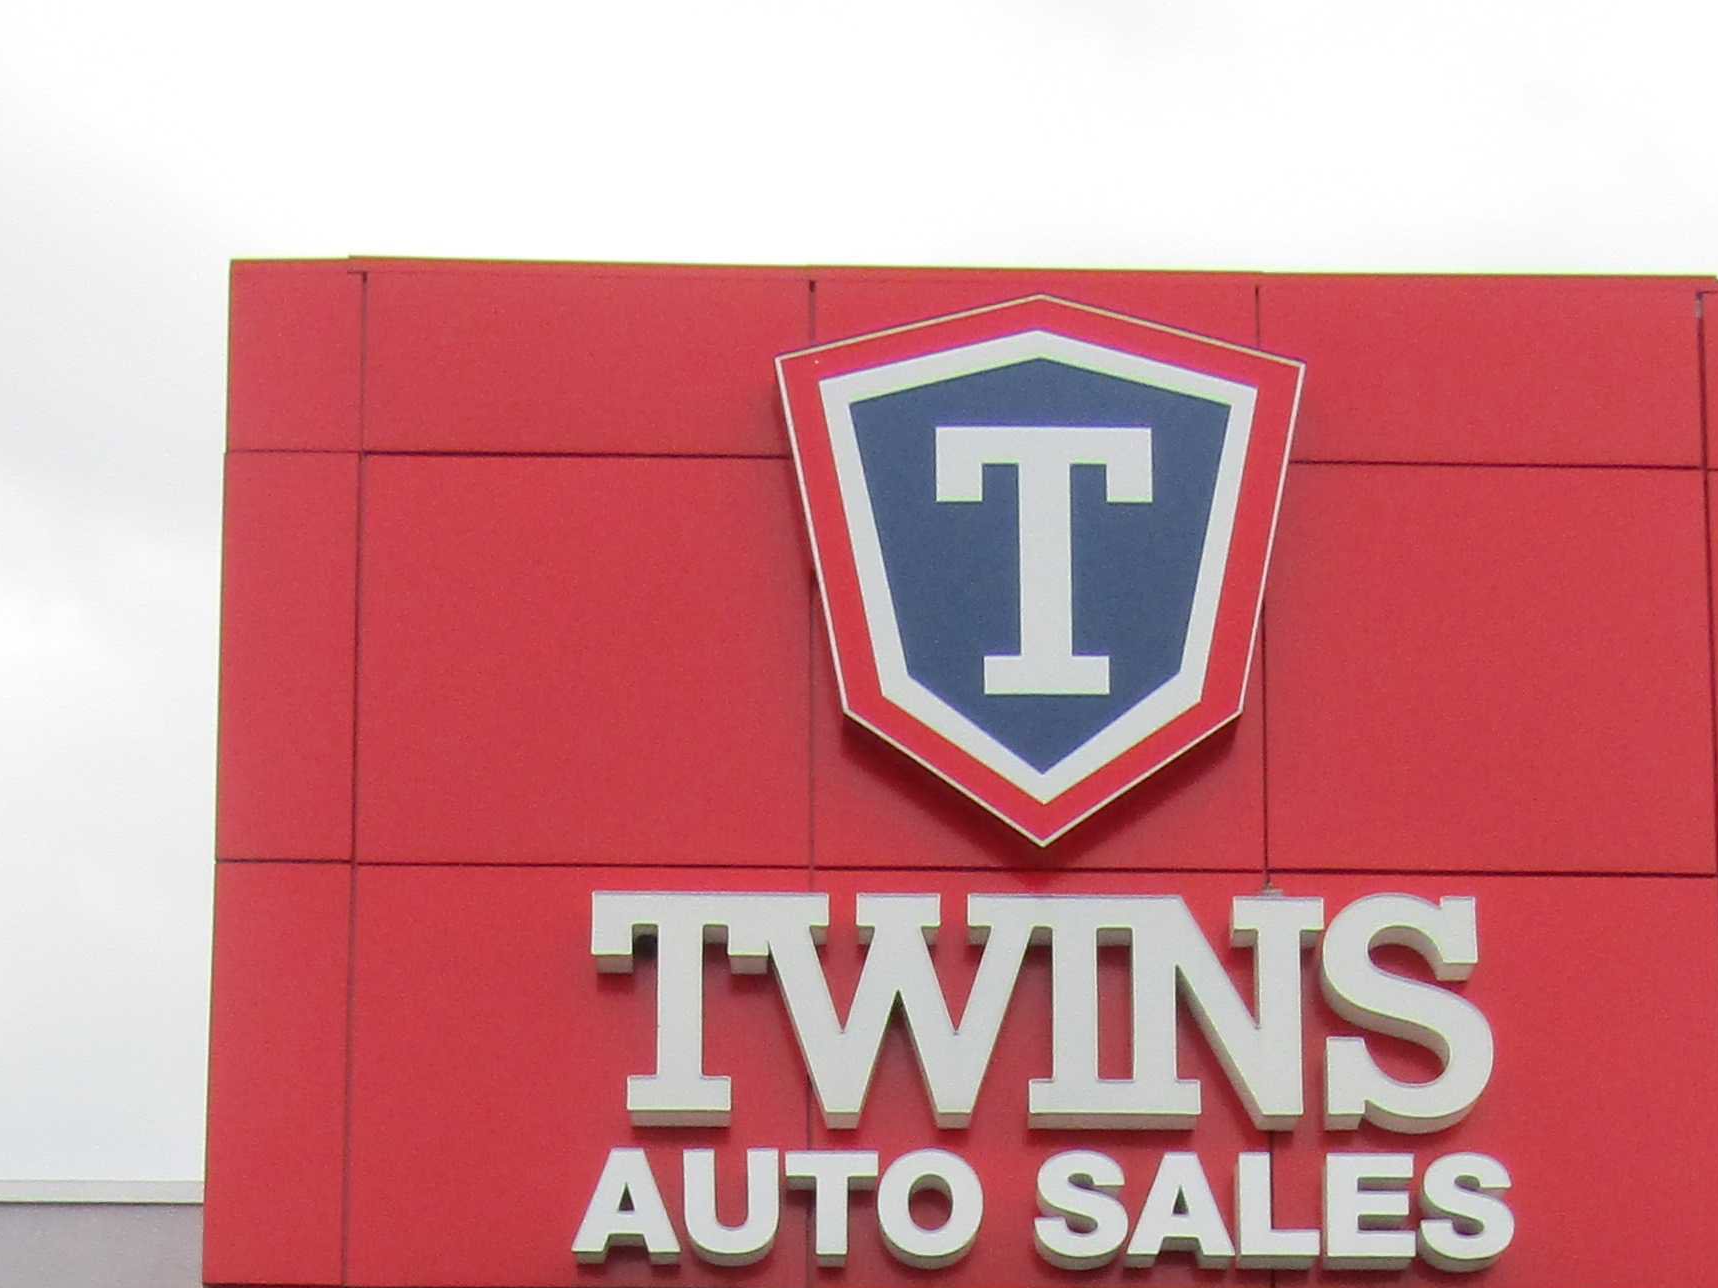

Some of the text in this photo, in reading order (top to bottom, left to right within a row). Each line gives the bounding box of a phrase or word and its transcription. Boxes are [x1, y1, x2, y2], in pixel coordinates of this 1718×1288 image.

[935, 426, 1153, 695] T
[591, 890, 1495, 1132] TWINS
[572, 1147, 1515, 1270] AUTO SALES
